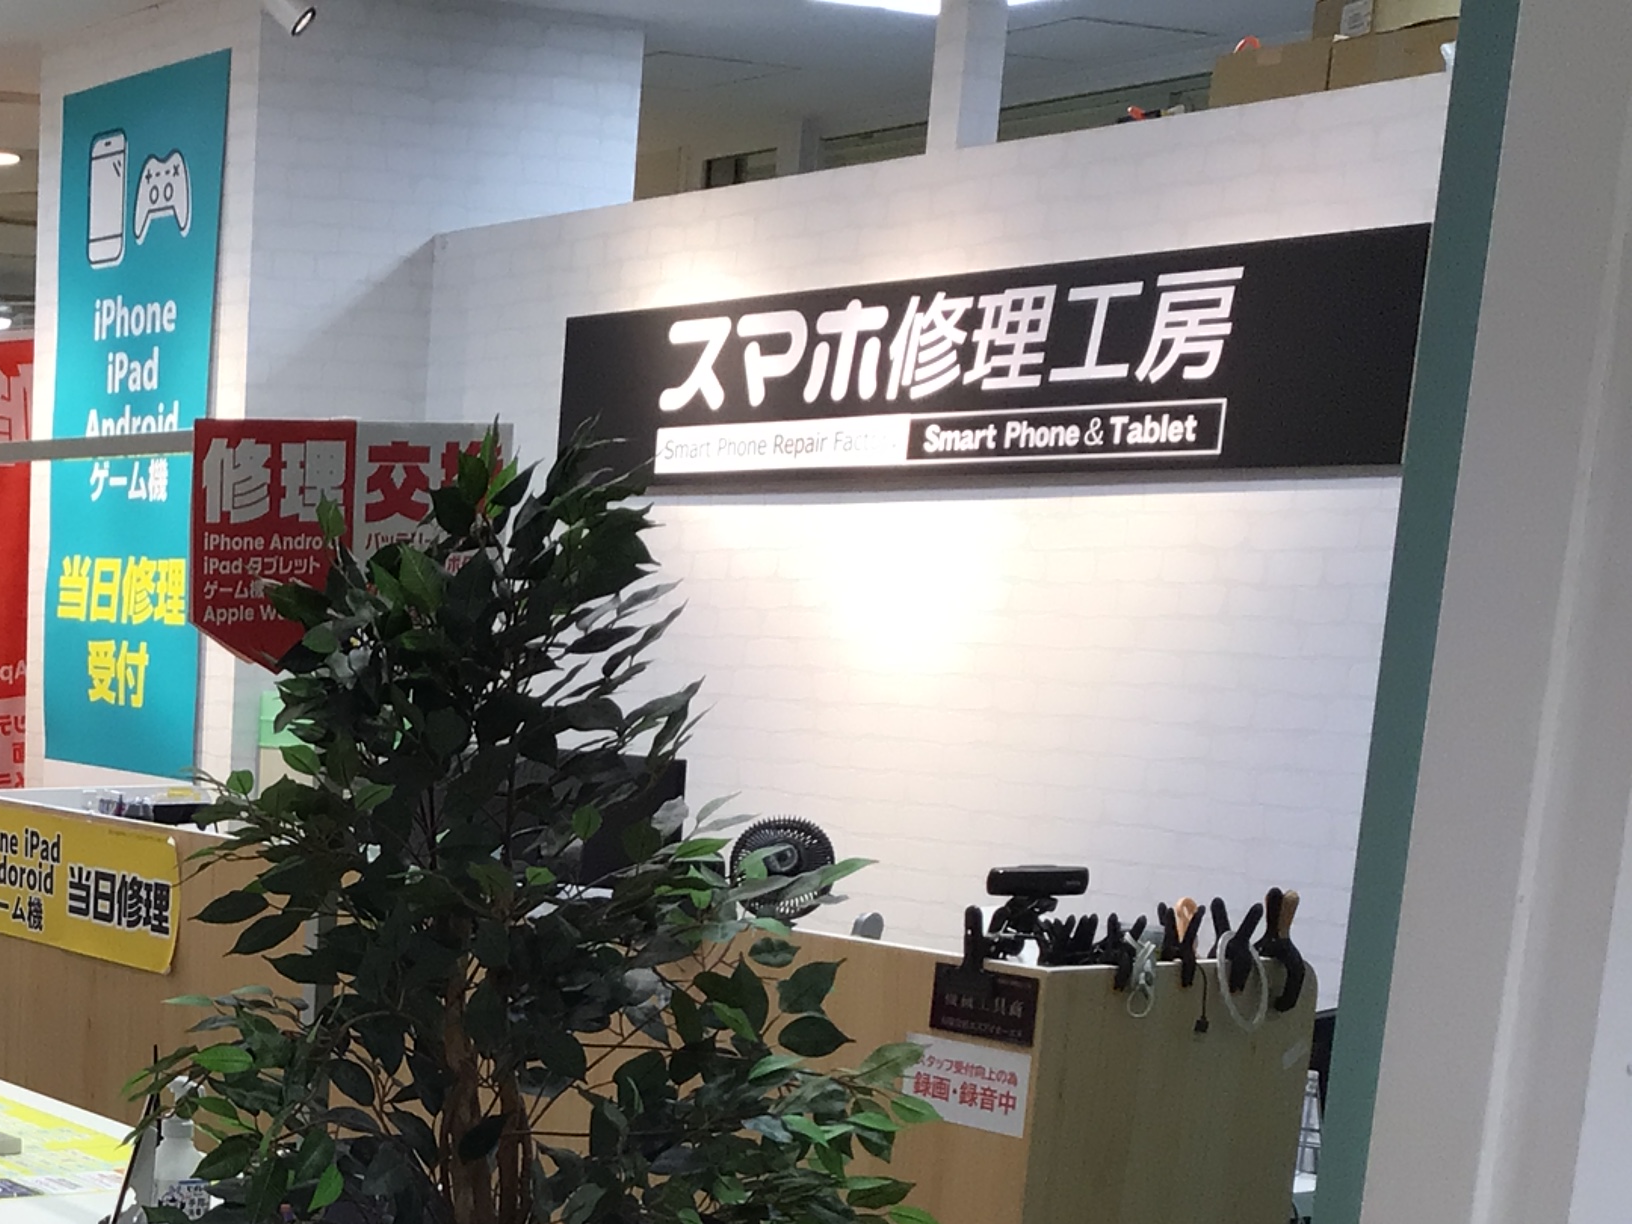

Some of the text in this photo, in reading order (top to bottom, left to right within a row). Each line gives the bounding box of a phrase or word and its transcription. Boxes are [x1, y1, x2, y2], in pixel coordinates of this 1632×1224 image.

[94, 294, 177, 342] iPhone
[659, 266, 1245, 412] スマホ修理工房
[107, 346, 159, 394] iPad
[774, 433, 828, 458] Repair
[923, 413, 1198, 453] Smart Phone & Tablet
[89, 457, 168, 502] ゲーム機
[203, 438, 348, 524] 修理
[204, 532, 340, 551] iPhone Andro
[204, 558, 242, 576] iPad
[56, 555, 187, 626] 当日修理
[203, 604, 256, 625] Apple
[87, 639, 149, 708] 受付
[24, 827, 61, 864] iPad
[67, 865, 170, 937] 当日修理
[913, 1071, 1017, 1116] 録画・録音中
